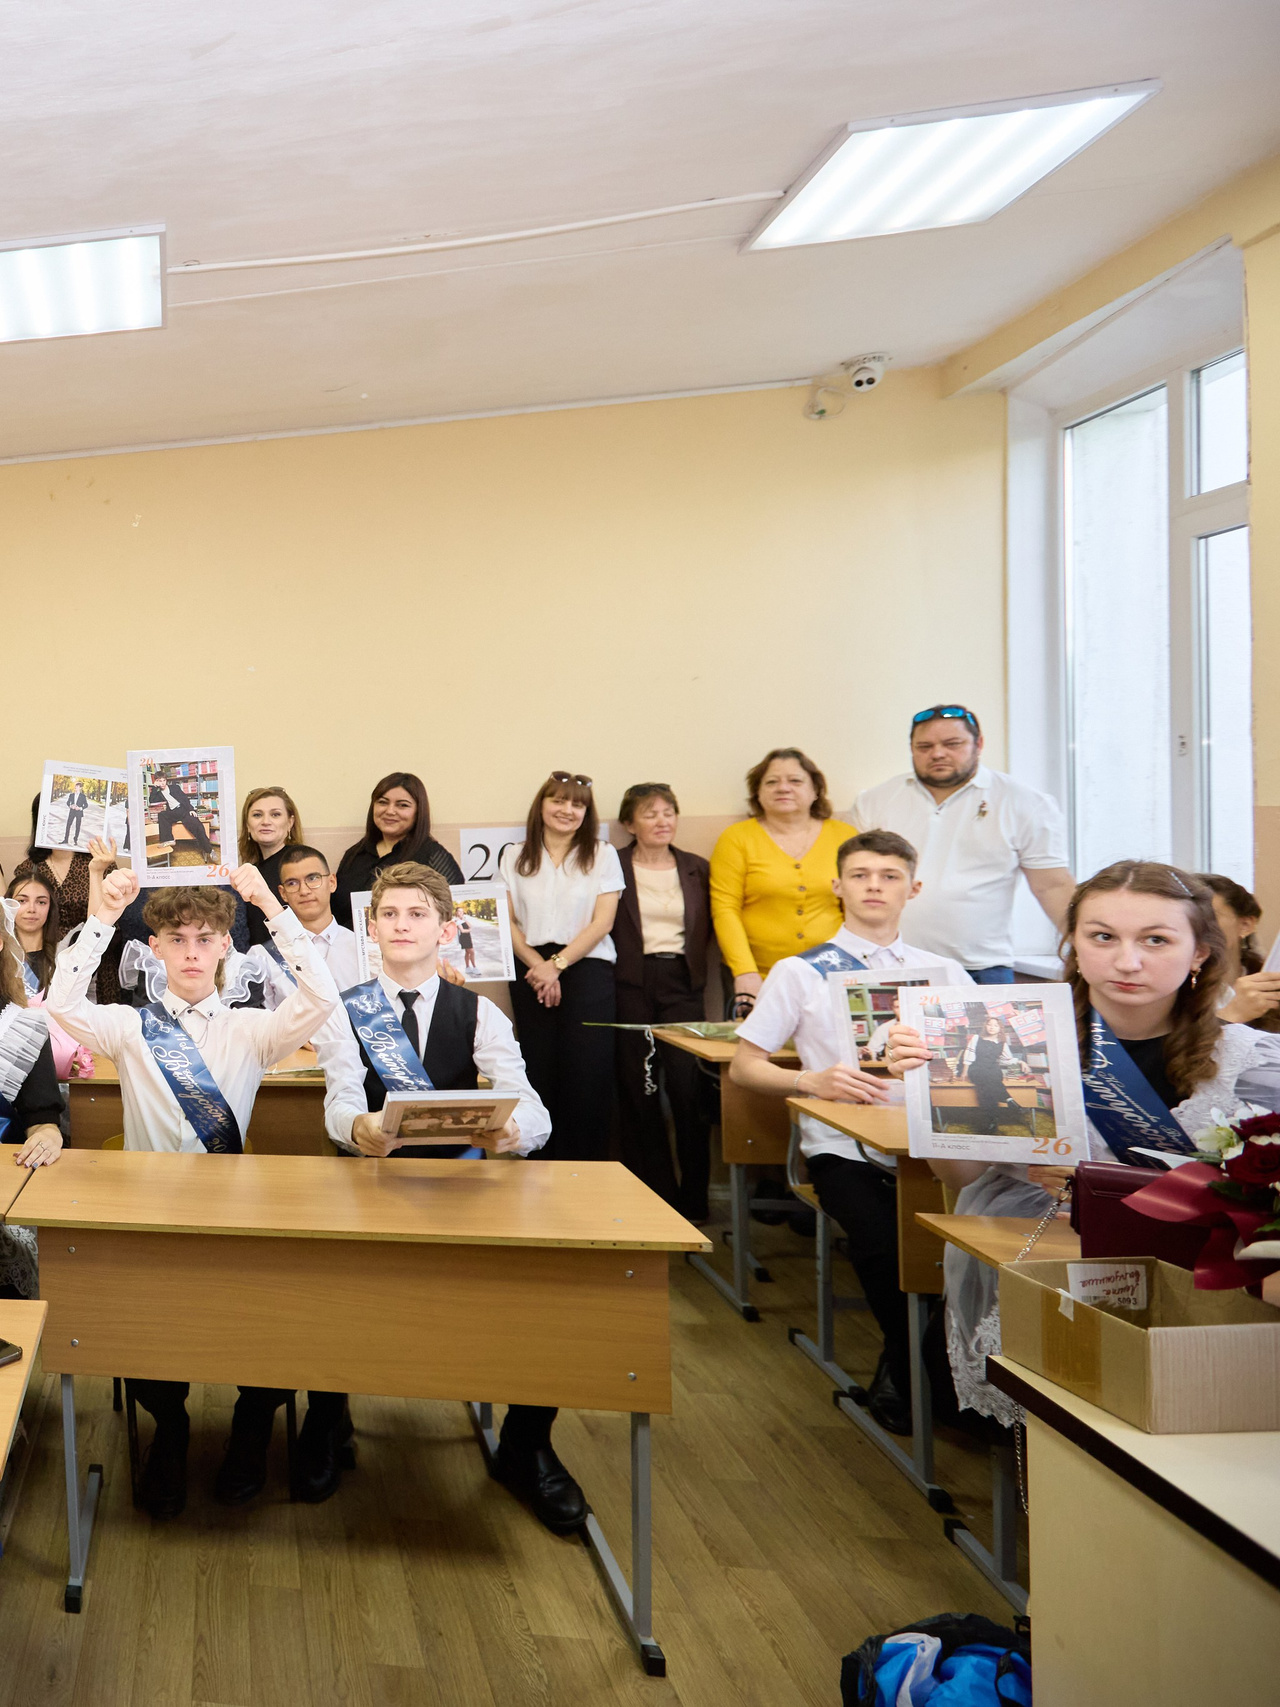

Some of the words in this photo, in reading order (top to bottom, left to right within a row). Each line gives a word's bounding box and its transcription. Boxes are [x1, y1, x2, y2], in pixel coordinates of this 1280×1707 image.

[139, 757, 155, 767] 20
[206, 862, 230, 878] 26
[919, 995, 940, 1006] 20
[1031, 1135, 1072, 1156] 26
